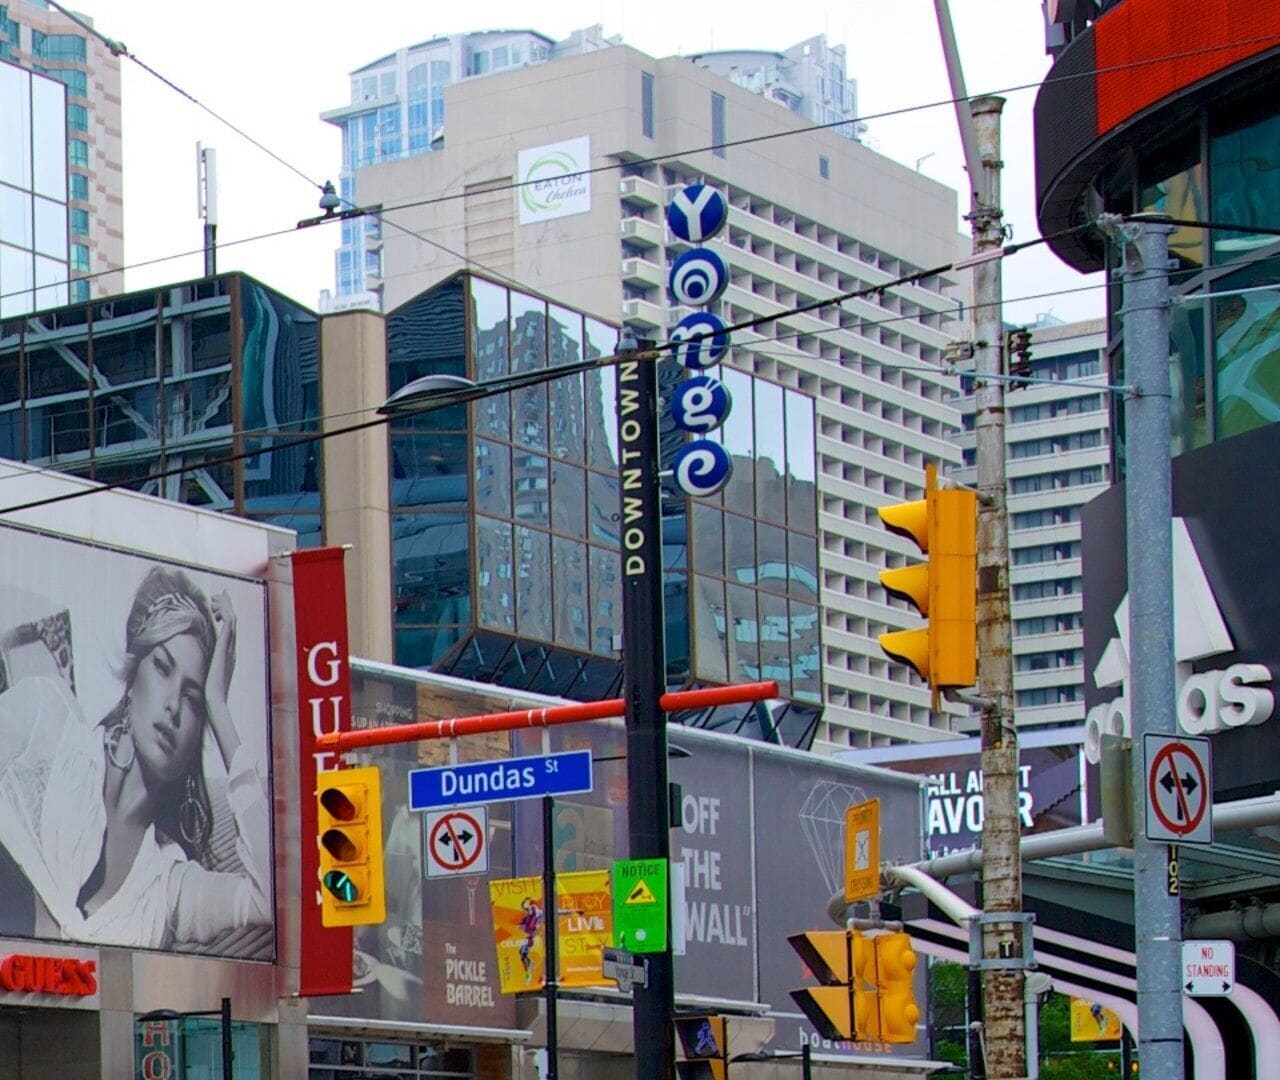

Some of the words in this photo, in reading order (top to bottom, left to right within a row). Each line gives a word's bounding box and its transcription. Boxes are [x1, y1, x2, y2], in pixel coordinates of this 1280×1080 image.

[669, 184, 733, 497] Yonge
[621, 360, 645, 575] DOWNTOWN
[441, 764, 536, 797] Dundas
[545, 759, 559, 774] St
[681, 794, 721, 836] OFF
[622, 863, 661, 877] NOTICE
[681, 847, 722, 891] THE
[493, 879, 537, 896] VISIT
[446, 942, 457, 954] The
[1201, 947, 1214, 959] NO
[446, 958, 487, 982] PICKLE
[1186, 964, 1228, 978] STANDING
[446, 981, 495, 1008] BARREL
